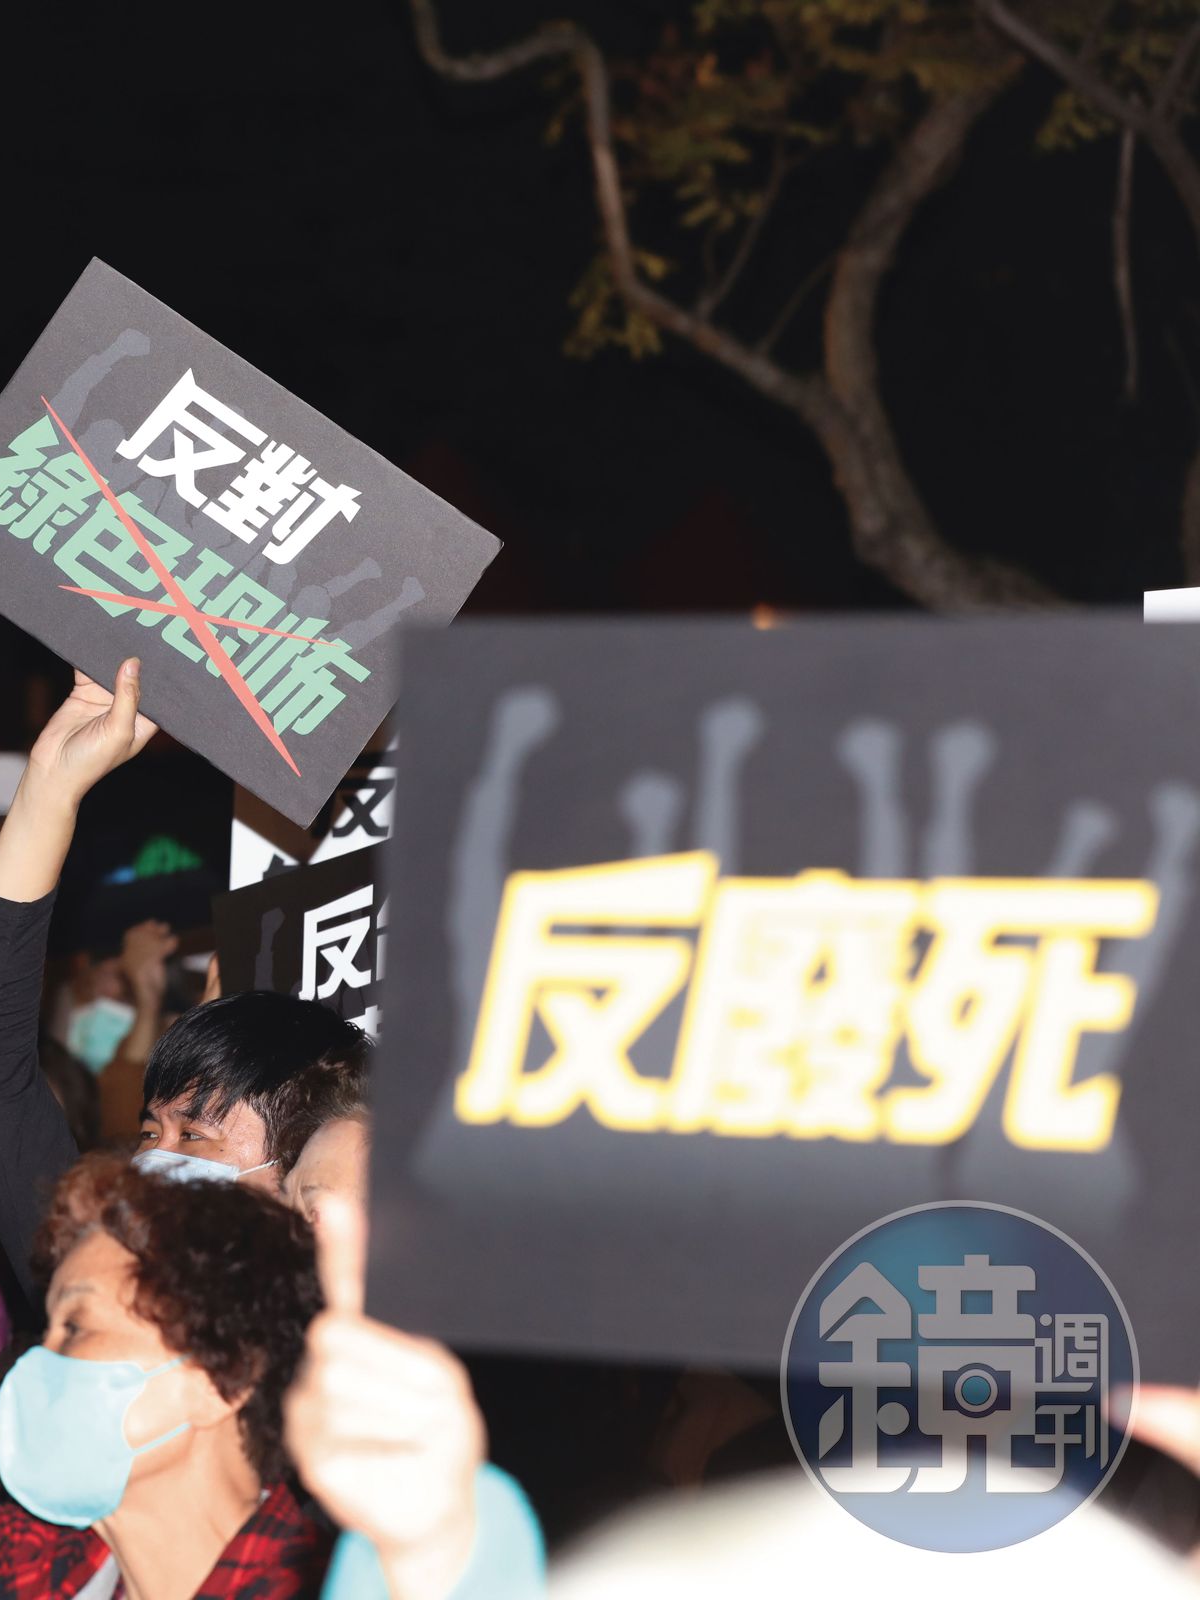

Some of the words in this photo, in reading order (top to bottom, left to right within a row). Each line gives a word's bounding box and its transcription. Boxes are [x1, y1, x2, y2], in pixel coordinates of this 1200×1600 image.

[115, 367, 363, 565] 反對
[298, 884, 390, 1002] 反
[455, 849, 1159, 1153] 反廢死
